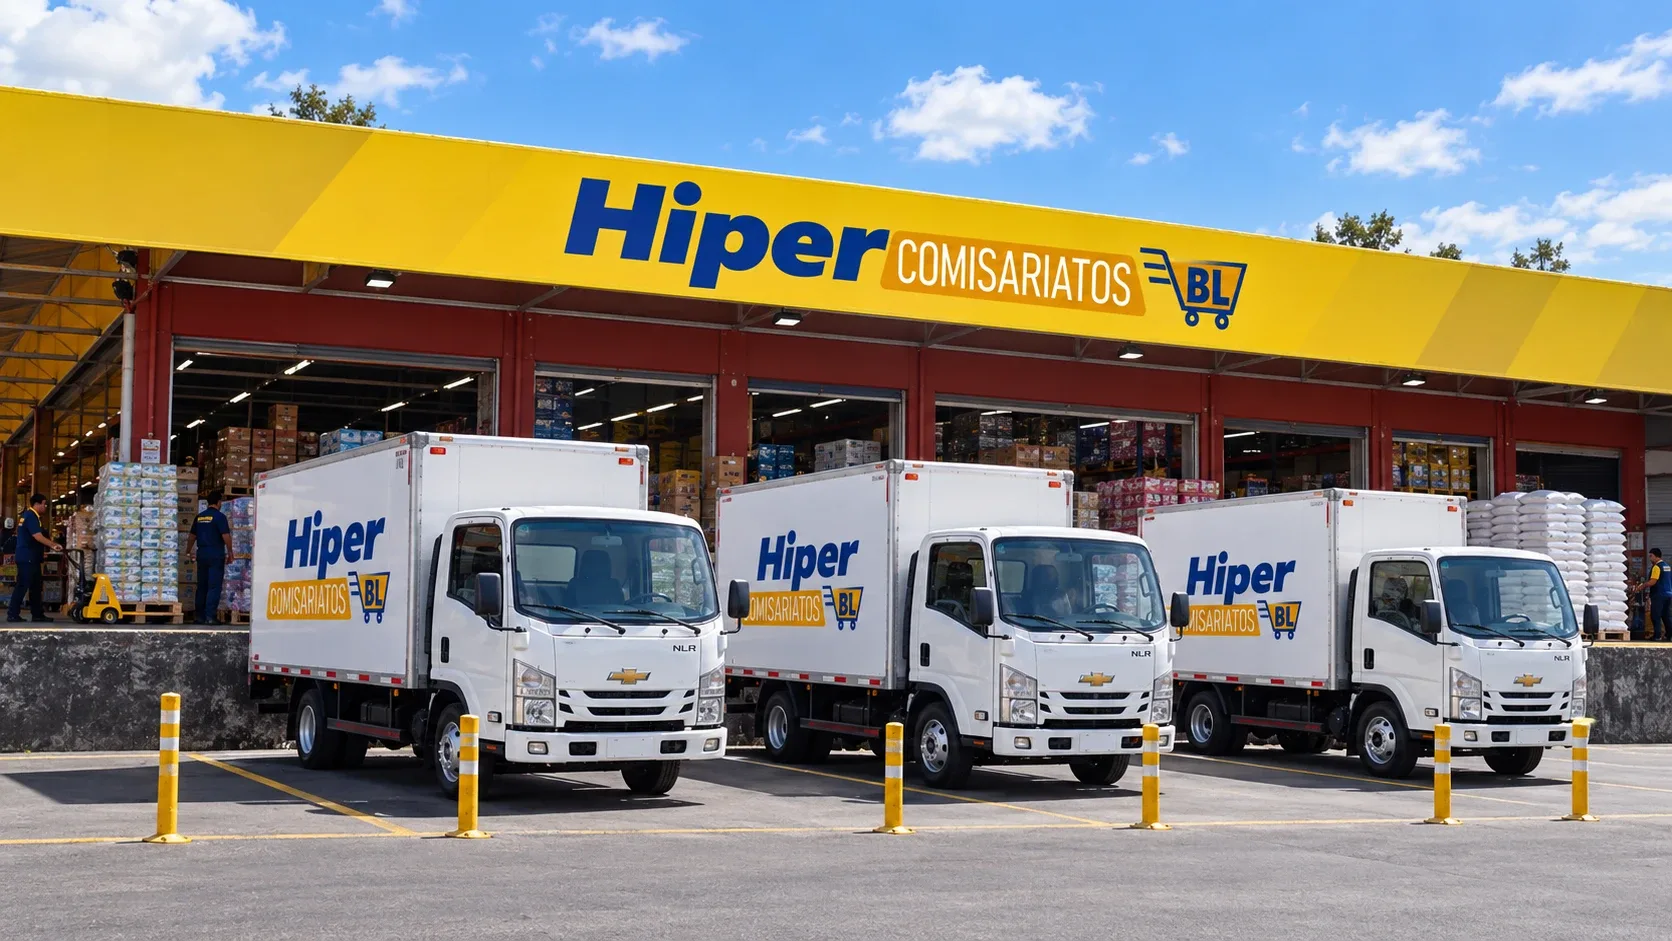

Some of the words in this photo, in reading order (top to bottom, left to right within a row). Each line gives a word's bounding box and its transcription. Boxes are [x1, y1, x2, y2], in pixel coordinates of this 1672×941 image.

[564, 177, 889, 289] Hiper
[898, 239, 1131, 307] COMISARIATOS
[1187, 266, 1230, 306] BL
[284, 509, 386, 580] Hiper
[757, 530, 860, 591] Hiper
[365, 579, 382, 606] BL
[1187, 551, 1297, 605] Hiper
[270, 583, 347, 615] COMISARIATOS
[745, 595, 820, 622] OMISARIATOS
[838, 592, 857, 616] BL
[1186, 609, 1255, 632] MISARIATOS
[1275, 606, 1294, 627] BL
[672, 644, 697, 652] NLR
